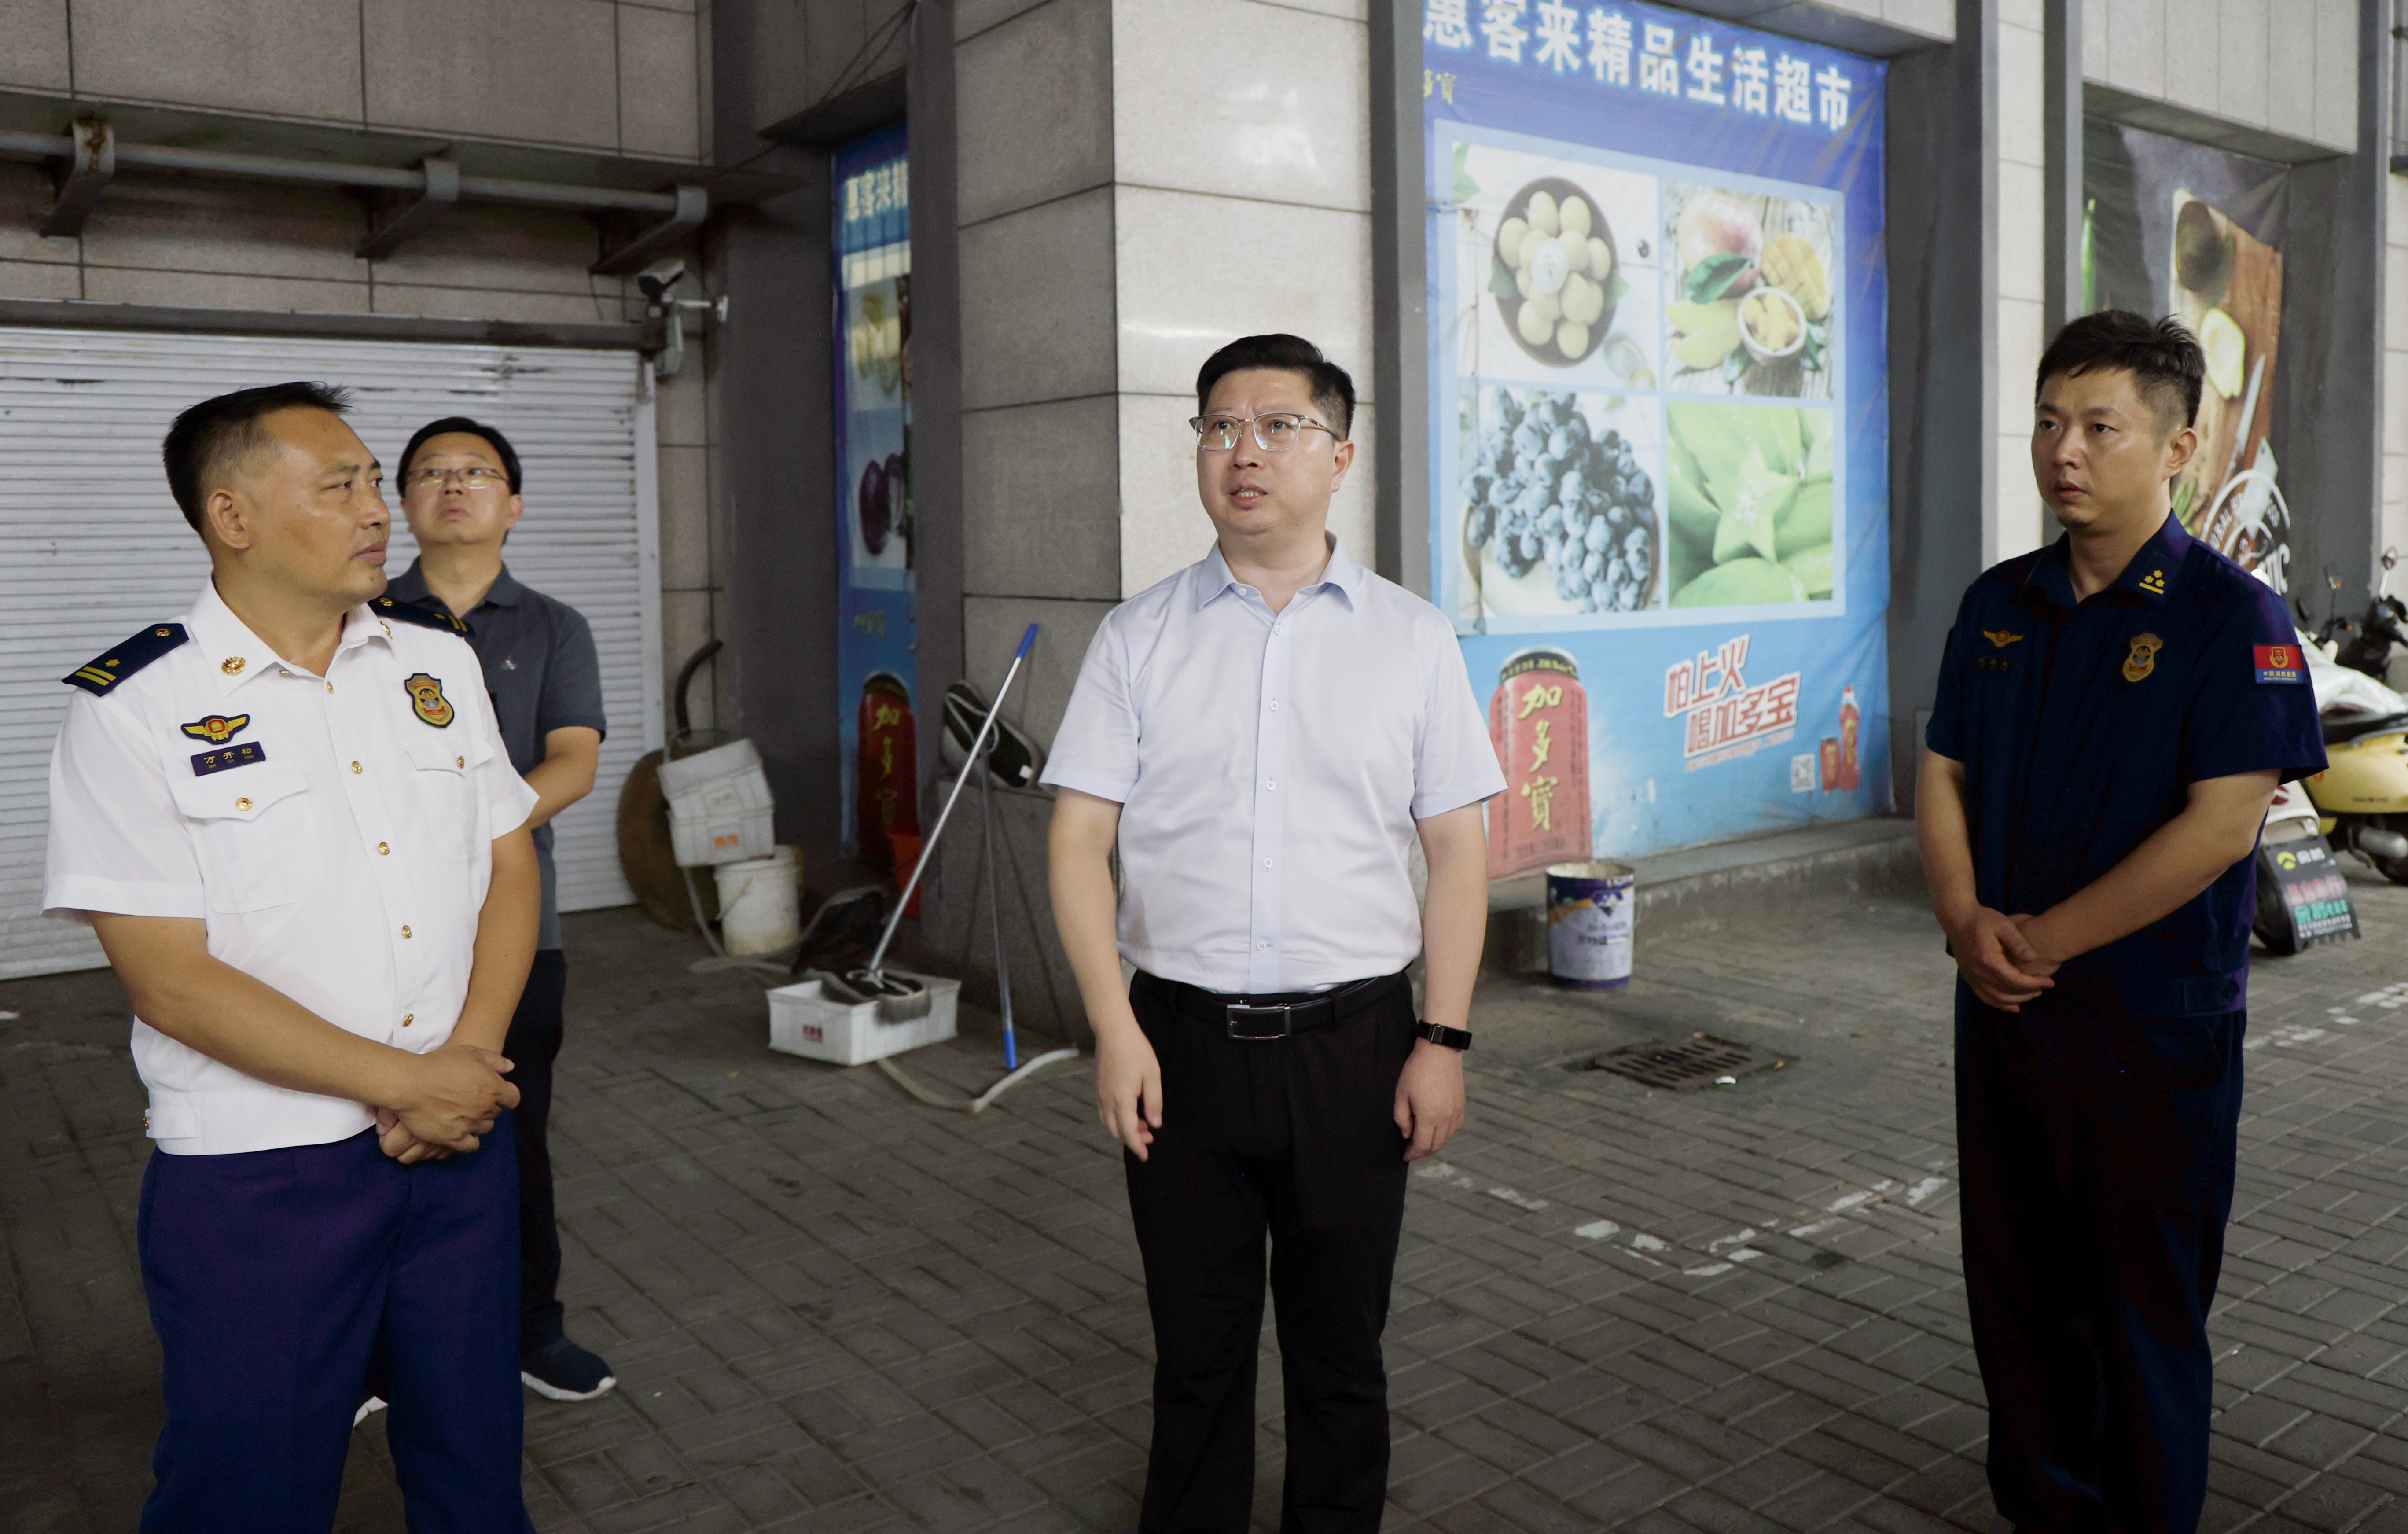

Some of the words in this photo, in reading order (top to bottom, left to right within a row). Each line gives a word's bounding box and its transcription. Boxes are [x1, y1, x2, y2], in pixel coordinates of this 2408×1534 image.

[1423, 0, 1851, 131] 惠客来精品生活超市
[1665, 635, 1750, 717] 怕上火
